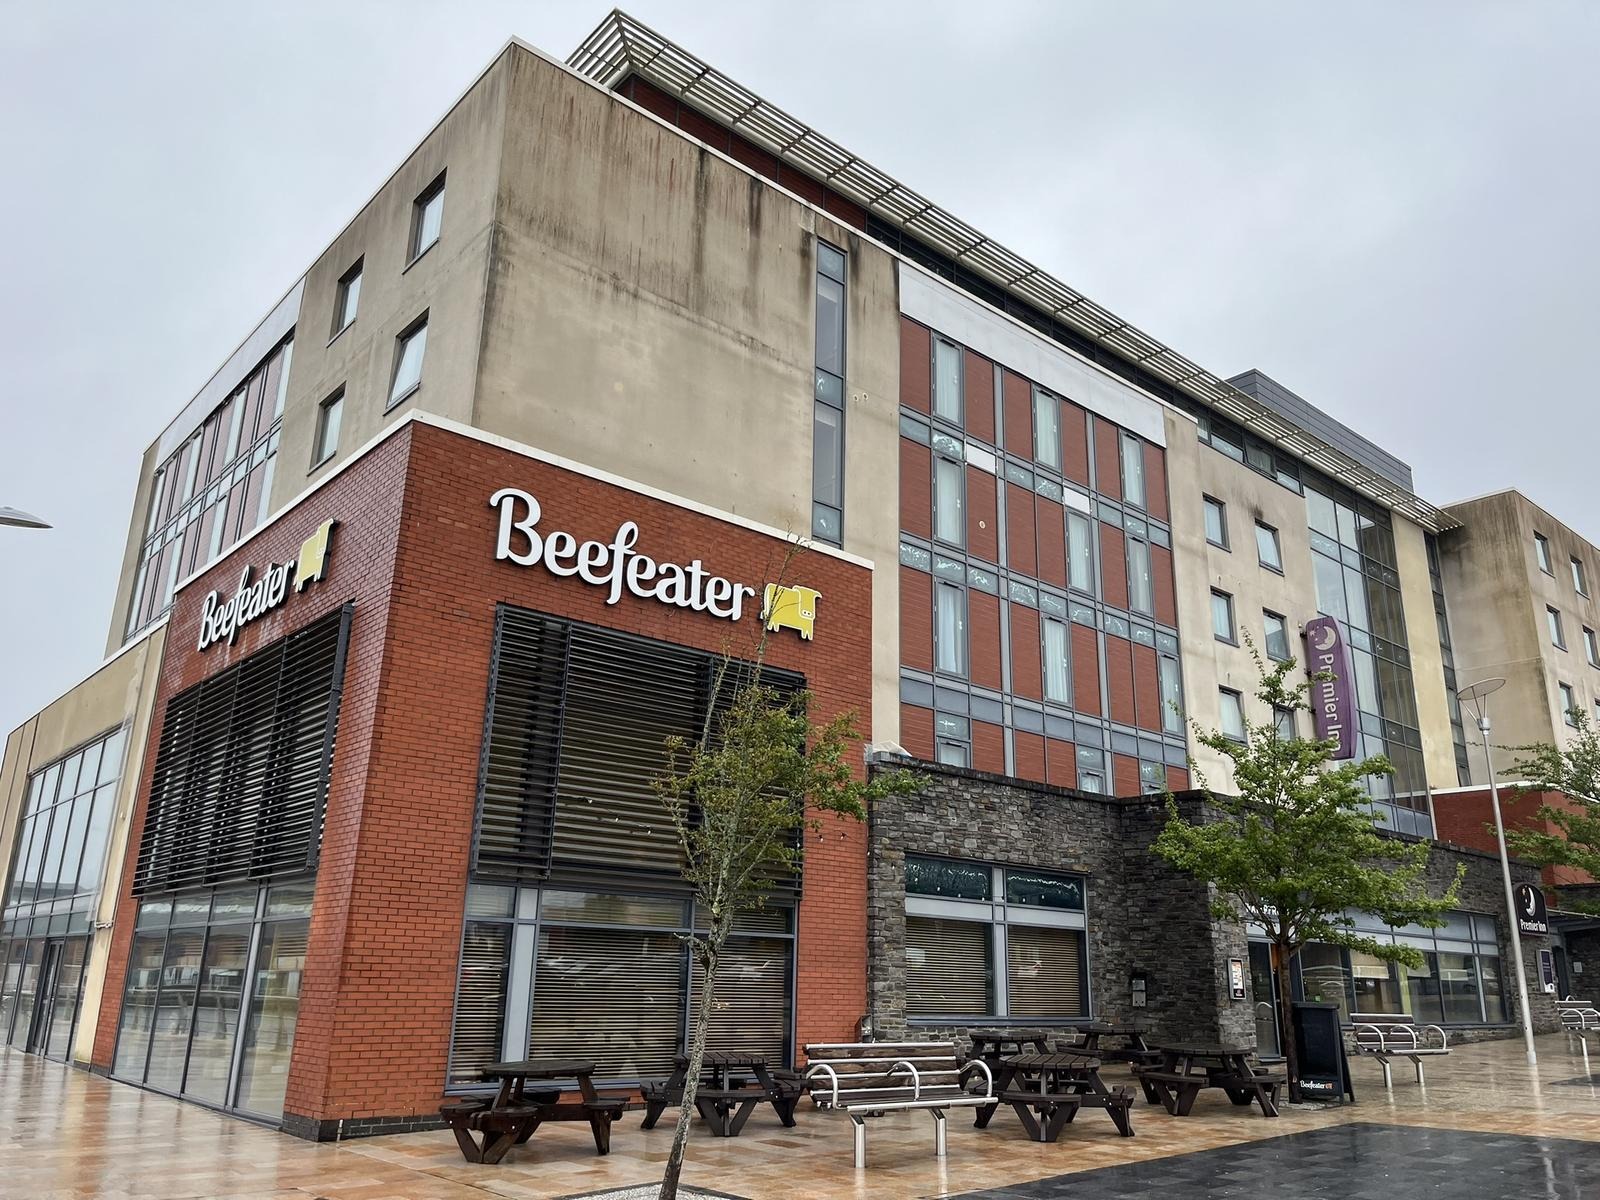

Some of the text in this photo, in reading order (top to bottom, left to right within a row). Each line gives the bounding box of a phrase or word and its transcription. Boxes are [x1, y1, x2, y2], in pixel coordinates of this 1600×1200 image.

[489, 487, 755, 622] Beefeater
[198, 559, 295, 652] Beefeater
[1300, 1080, 1325, 1089] Beefeater
